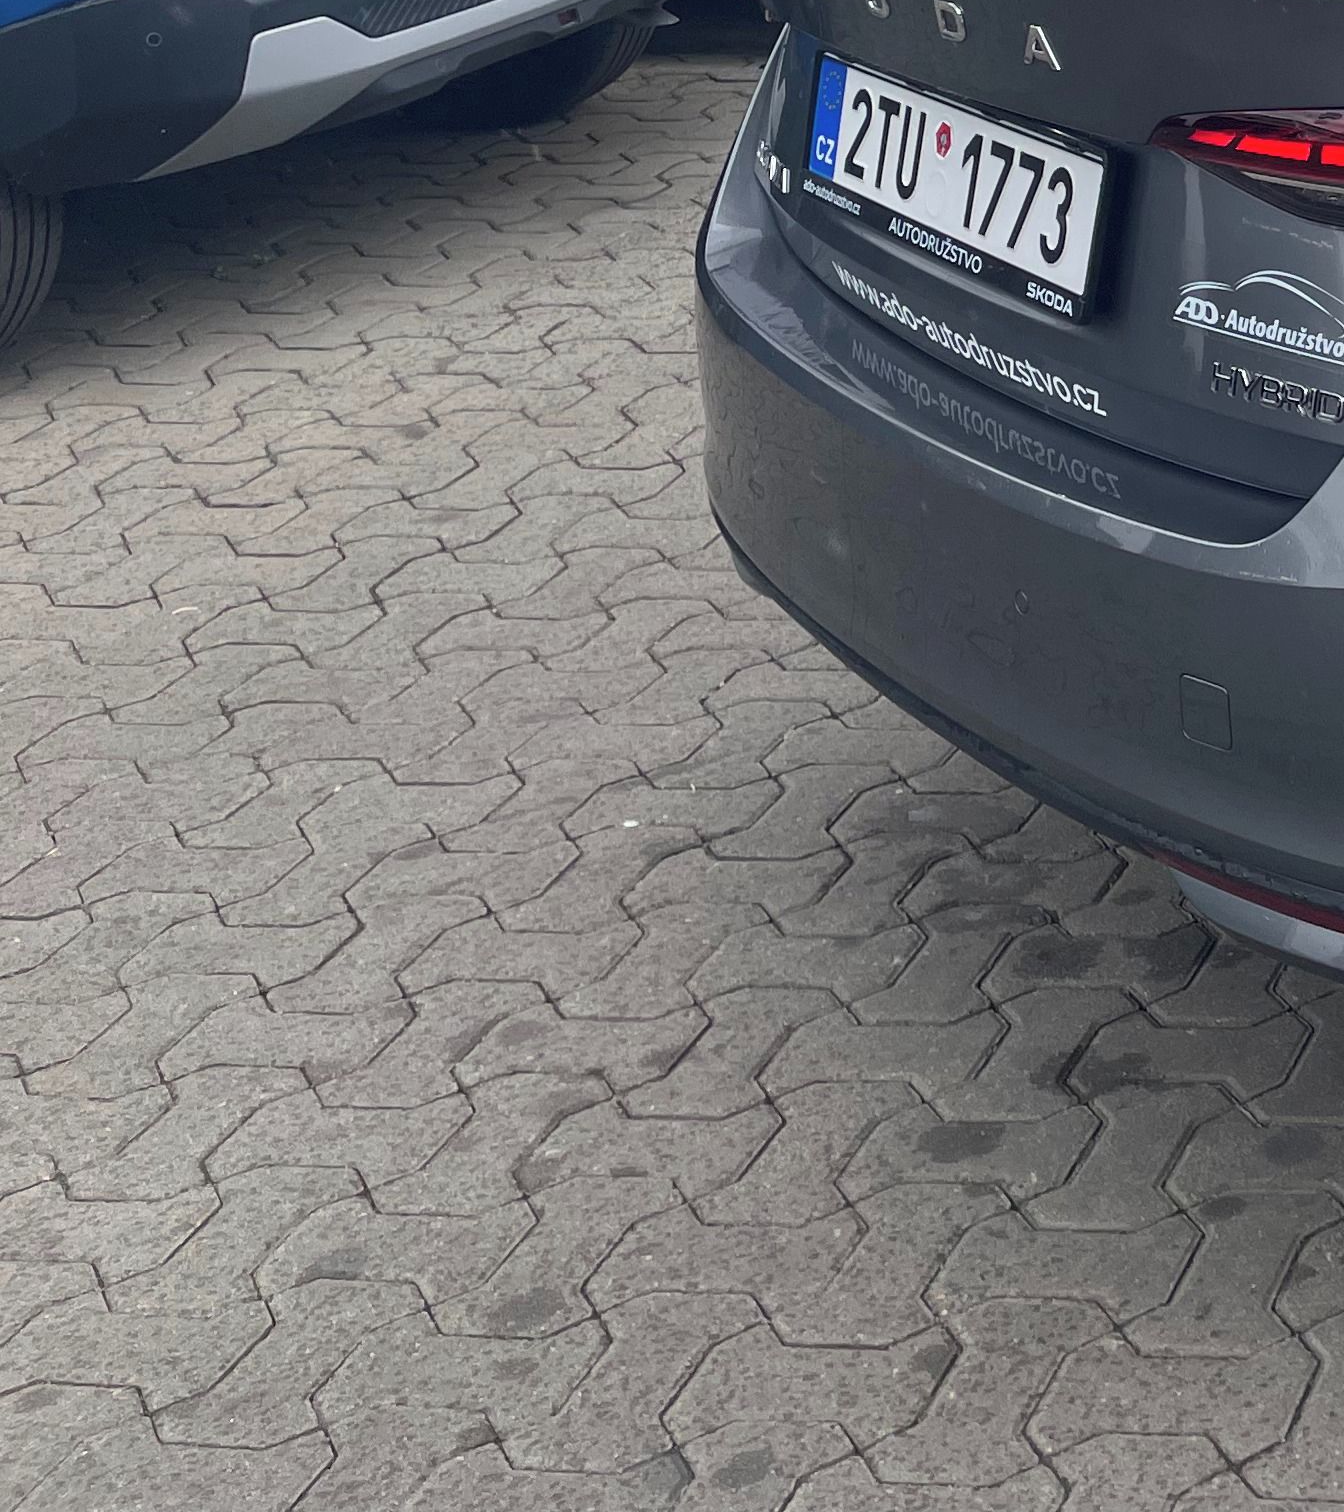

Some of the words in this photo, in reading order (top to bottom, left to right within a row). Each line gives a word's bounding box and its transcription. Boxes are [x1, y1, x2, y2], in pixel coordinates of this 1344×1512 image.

[815, 135, 835, 166] CZ
[844, 88, 928, 201] 2TU
[962, 133, 1074, 265] 1773
[888, 217, 983, 275] AUTODRUŽSTVO
[832, 260, 1107, 417] www.ado-autodruzstvo.cz
